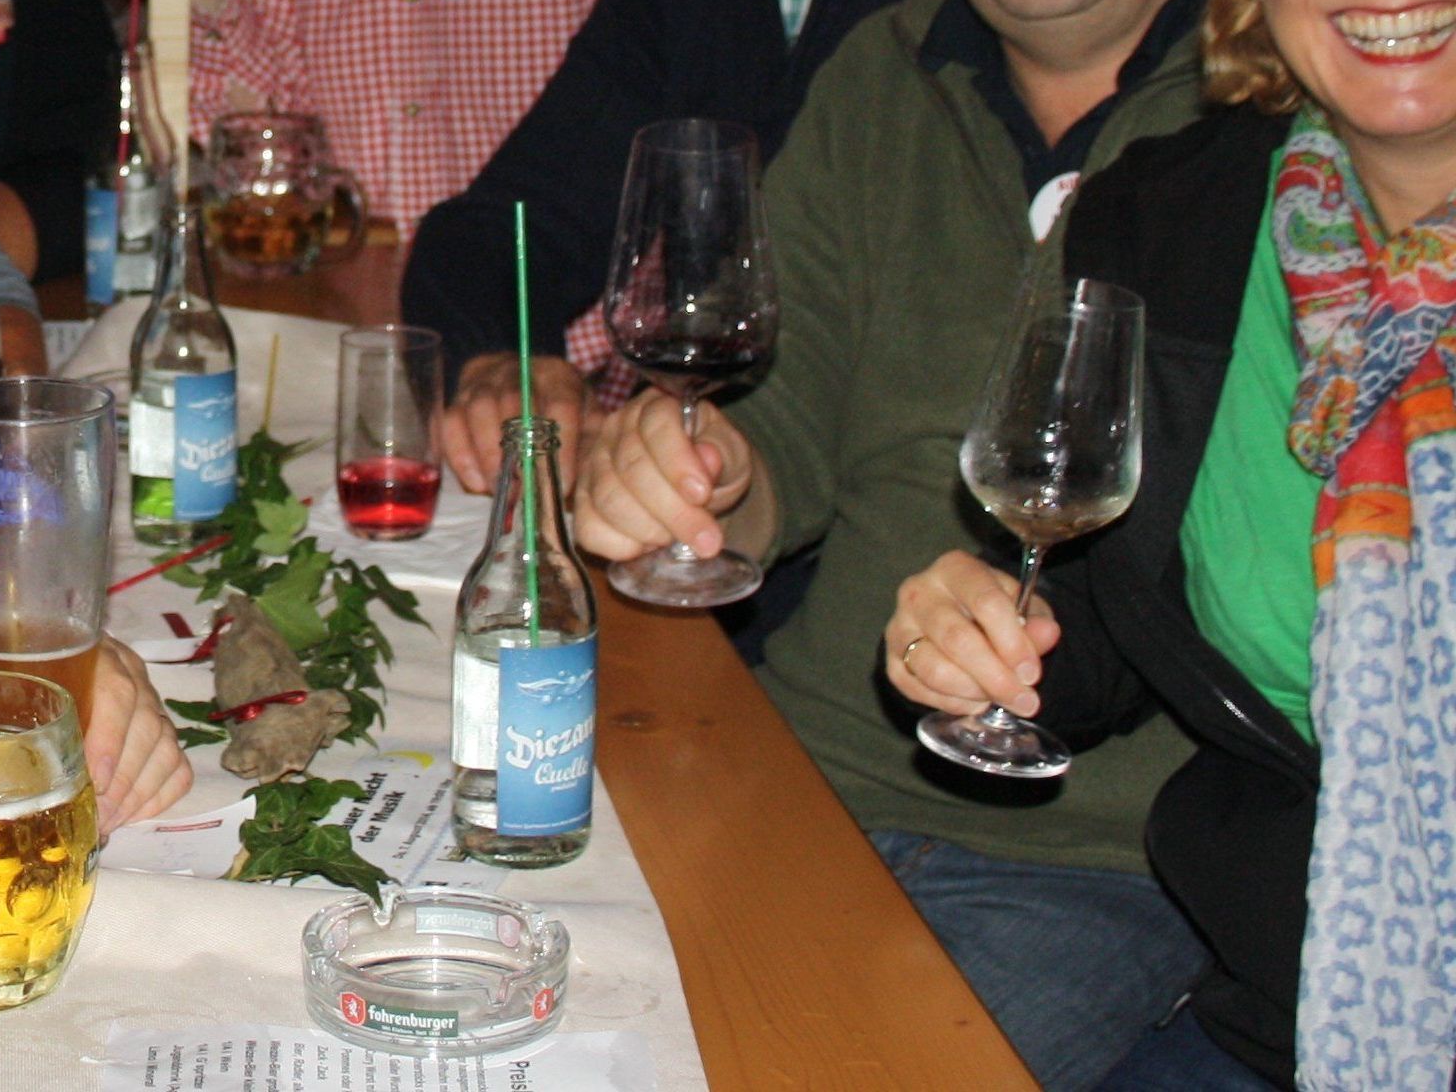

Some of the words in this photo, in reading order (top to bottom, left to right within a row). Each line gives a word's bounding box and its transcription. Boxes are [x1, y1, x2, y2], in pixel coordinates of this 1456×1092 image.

[356, 825, 382, 844] der
[369, 790, 407, 823] Musik
[368, 1005, 455, 1031] fohrenburger
[317, 1045, 329, 1061] Zack
[341, 1047, 352, 1075] Pommes
[317, 1065, 329, 1080] Zack
[341, 1076, 352, 1089] oder
